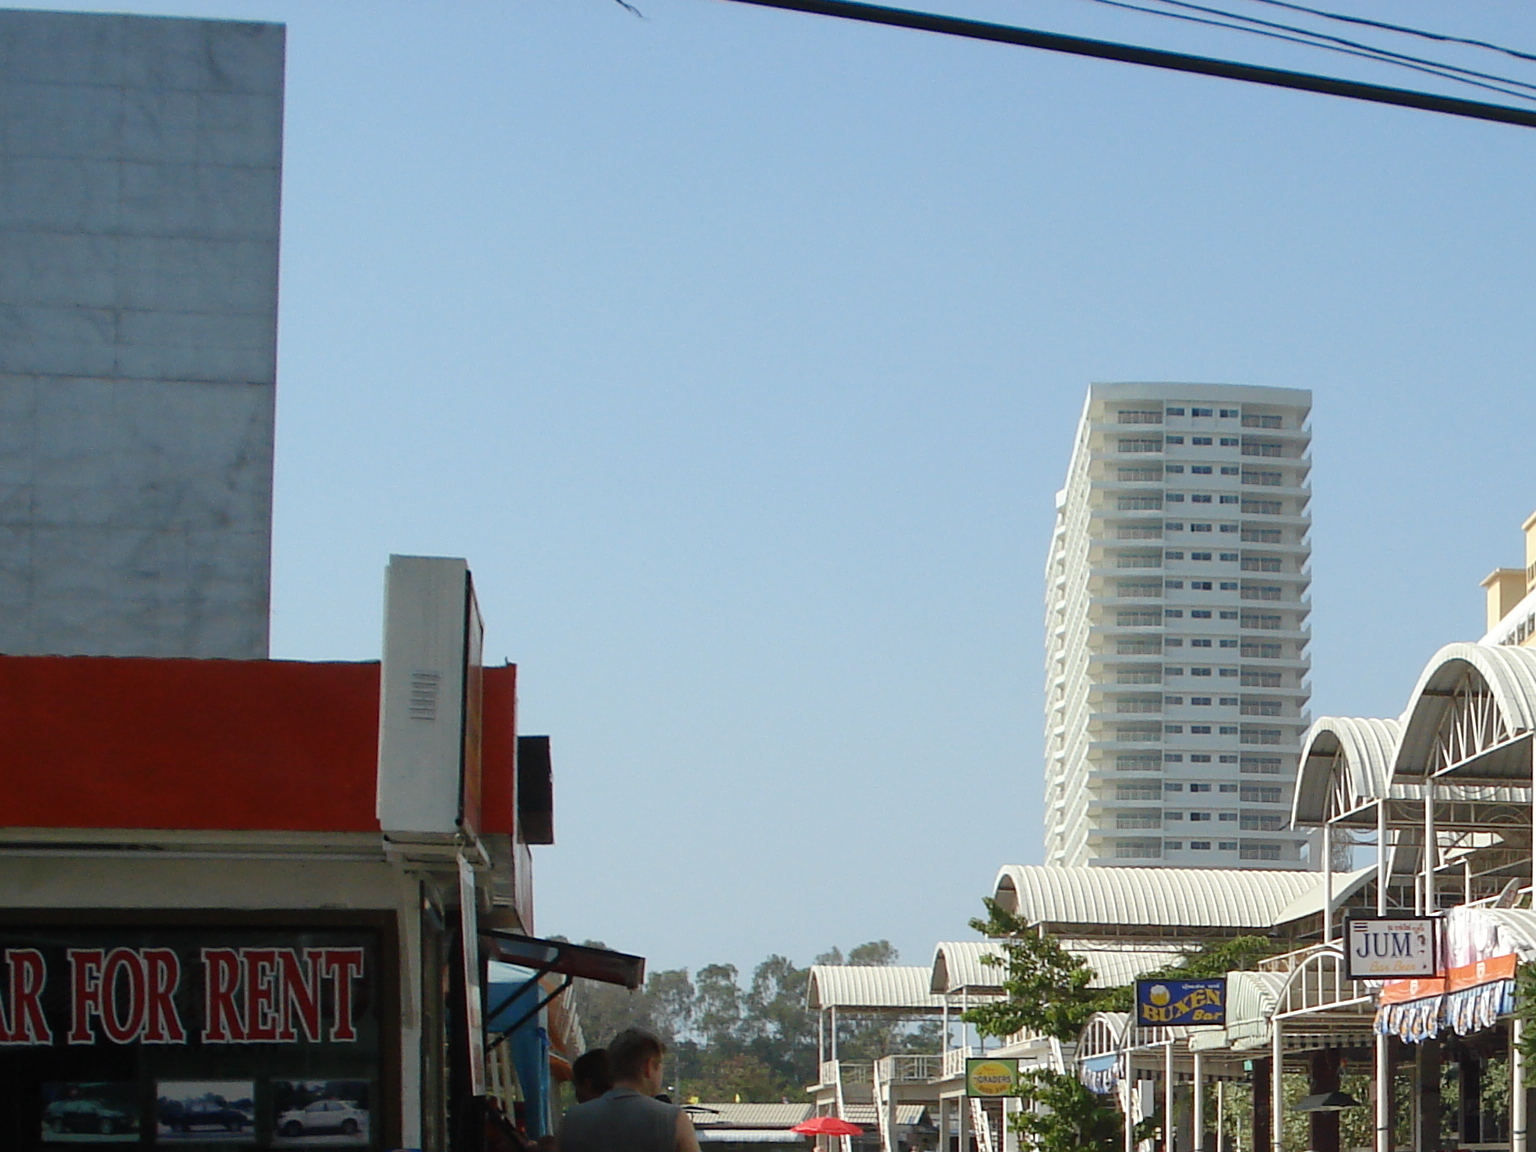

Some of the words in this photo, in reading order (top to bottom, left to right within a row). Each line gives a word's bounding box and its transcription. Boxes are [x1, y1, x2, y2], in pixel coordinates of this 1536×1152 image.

[1356, 932, 1414, 958] JUM
[0, 947, 52, 1045] R
[67, 946, 187, 1045] FOR
[201, 946, 364, 1045] RENT
[1142, 988, 1222, 1022] BUXEN
